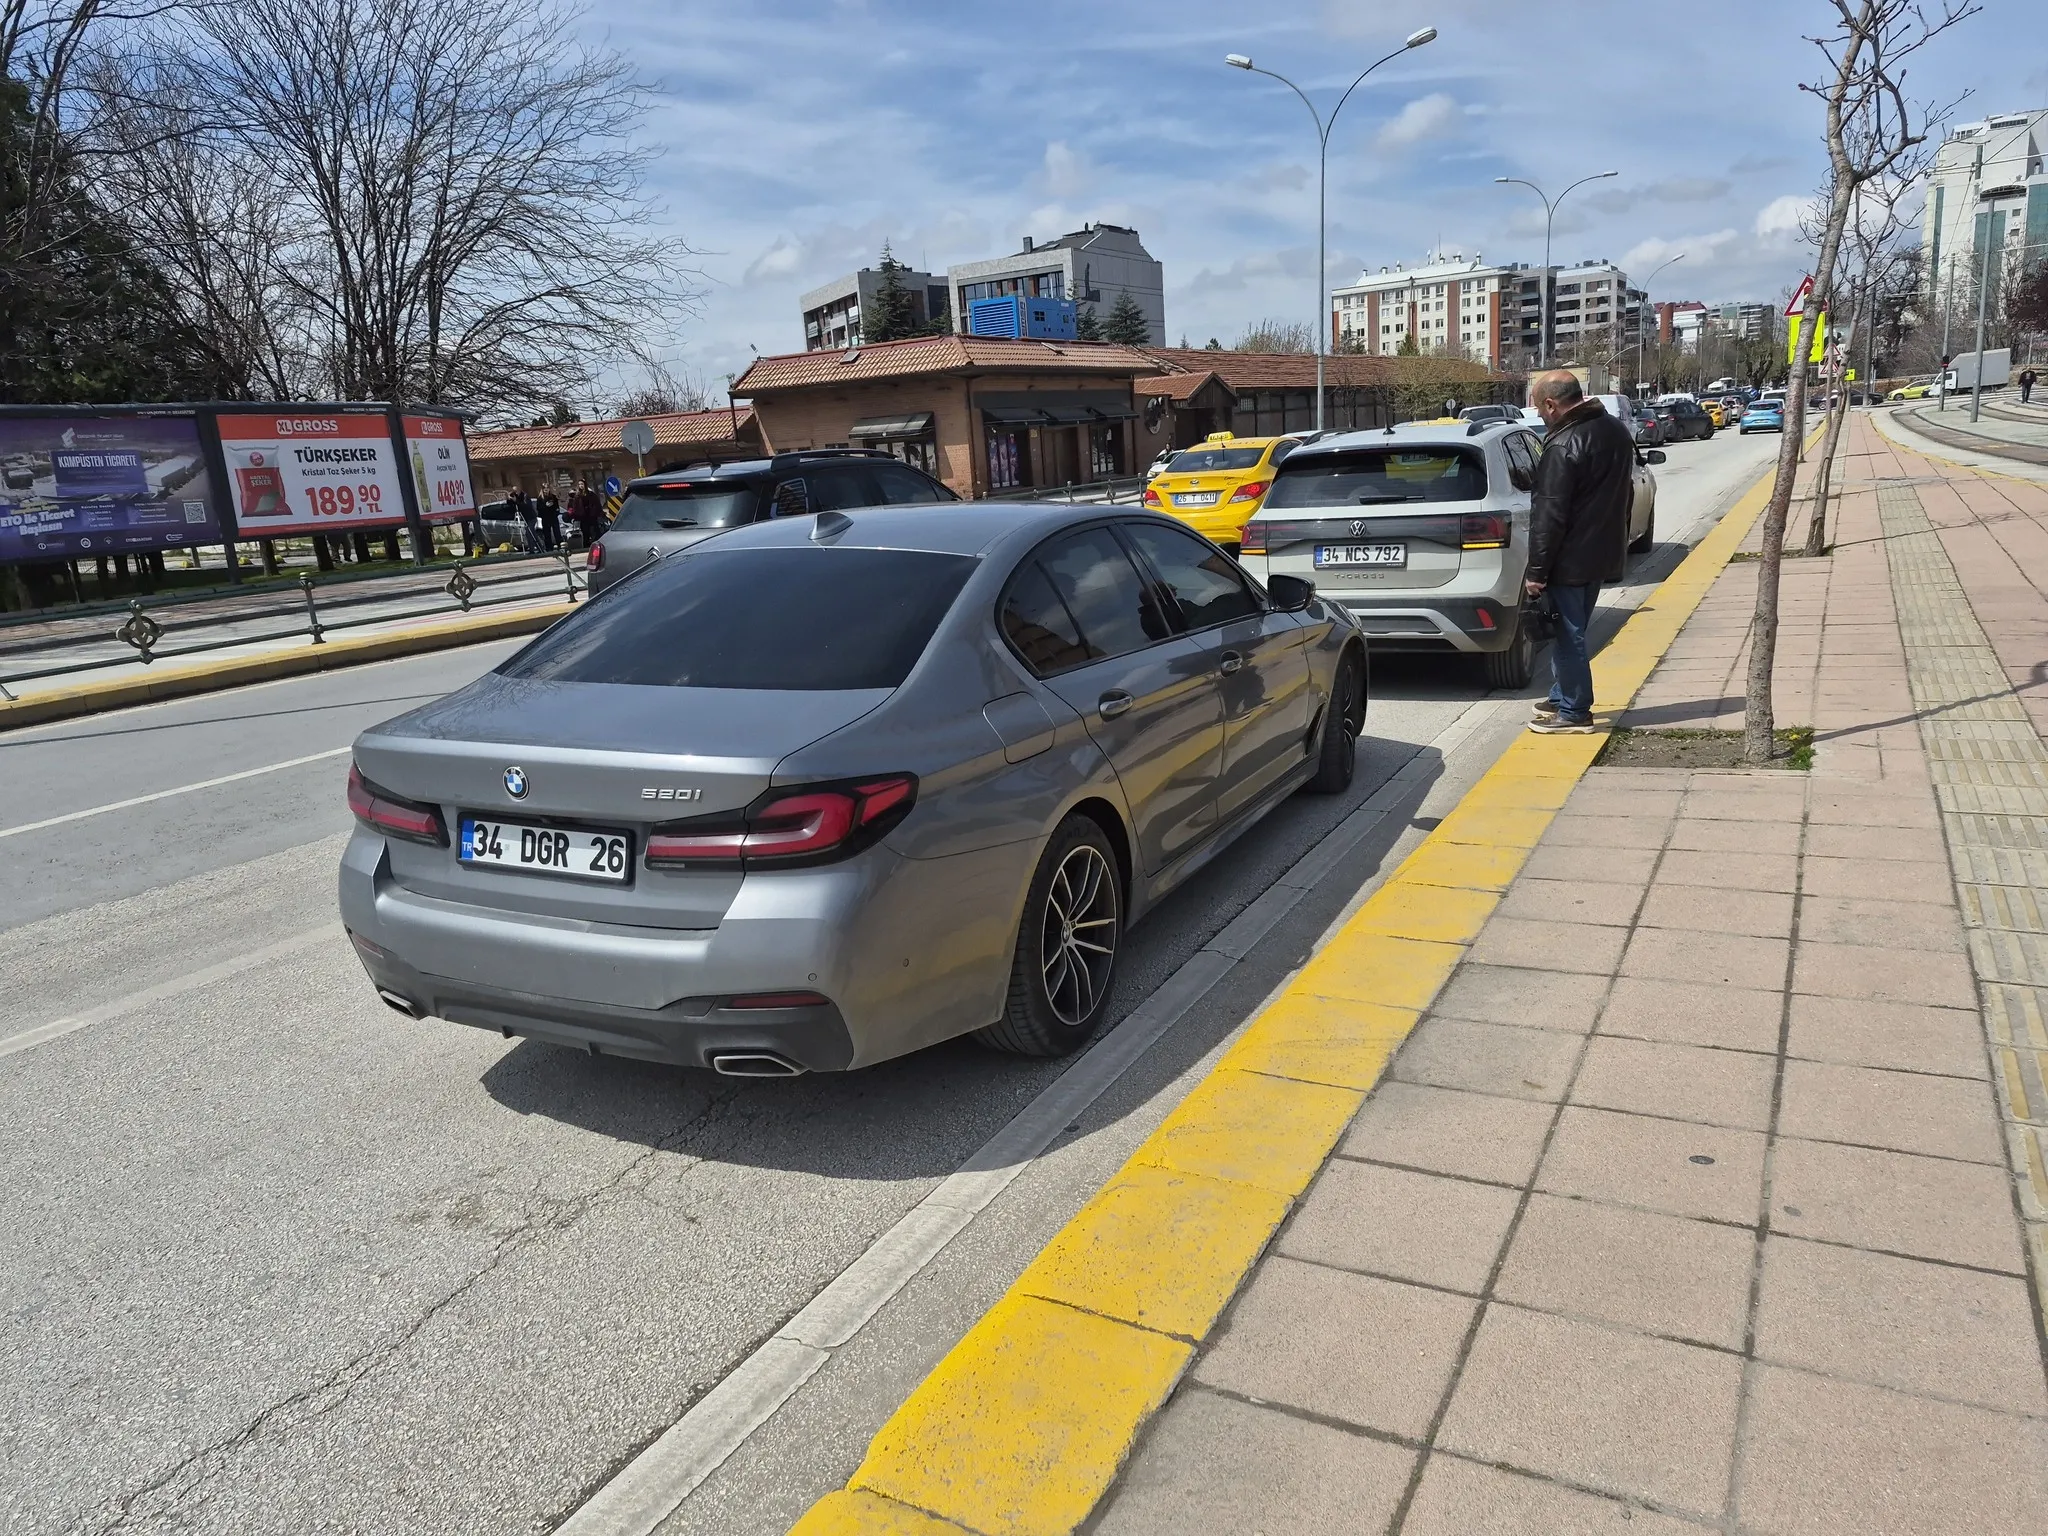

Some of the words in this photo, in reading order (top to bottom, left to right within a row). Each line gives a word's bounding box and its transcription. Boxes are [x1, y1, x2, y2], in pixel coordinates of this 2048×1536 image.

[276, 420, 291, 434] XL
[293, 419, 338, 432] GROSS
[57, 453, 104, 468] KAMPÜSTEN
[104, 452, 137, 467] TİCARETE
[294, 446, 378, 464] TÜRKŞEKER
[302, 467, 326, 477] Kristal
[326, 467, 340, 476] Toz
[341, 467, 360, 476] Şeker
[361, 466, 366, 474] 5
[367, 466, 376, 475] kg
[1178, 495, 1187, 503] 26
[1191, 494, 1196, 502] T
[1200, 493, 1216, 502] 0411
[366, 502, 383, 513] TL
[0, 515, 23, 528] ETO
[38, 508, 75, 522] Ticaret
[19, 522, 63, 536] Başlasın
[1323, 547, 1339, 562] 34
[1345, 546, 1370, 562] NCS
[1375, 546, 1400, 562] 792
[462, 841, 473, 855] TR
[473, 823, 503, 862] 34
[520, 828, 570, 868] DGR
[589, 837, 625, 873] 26
